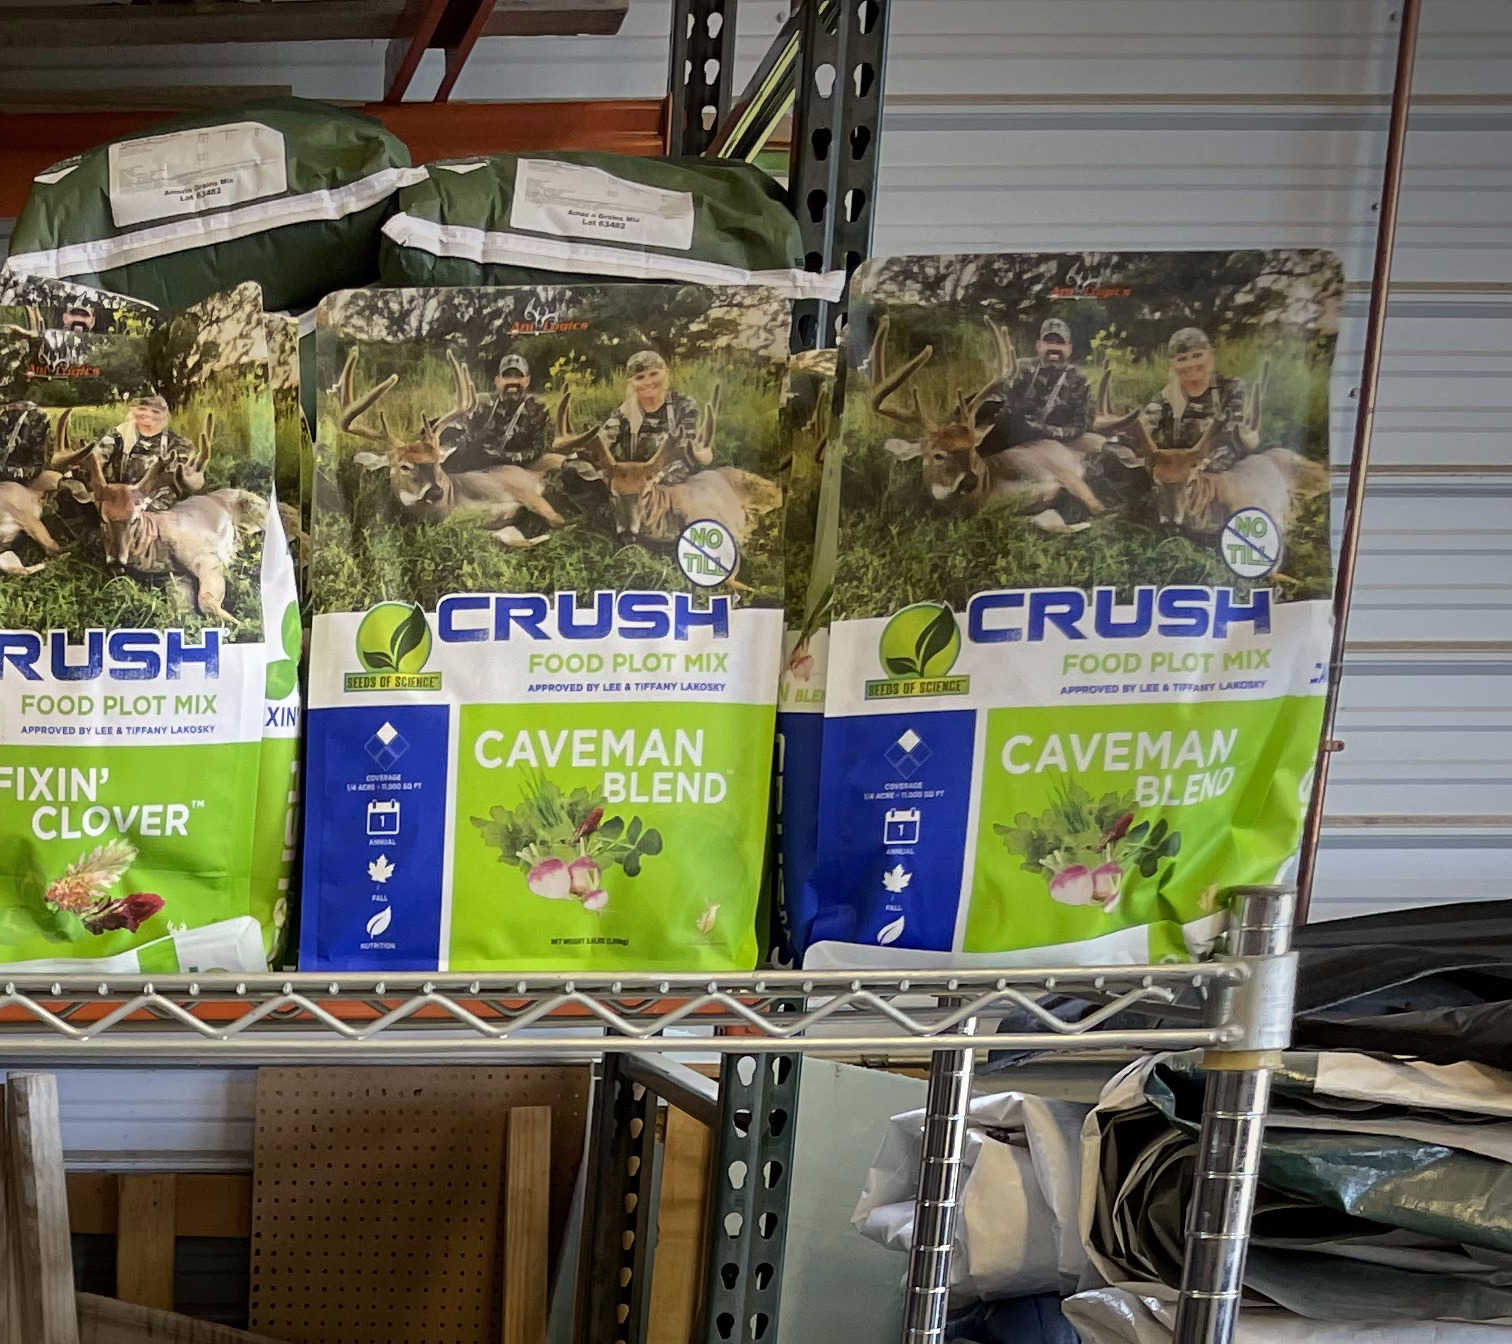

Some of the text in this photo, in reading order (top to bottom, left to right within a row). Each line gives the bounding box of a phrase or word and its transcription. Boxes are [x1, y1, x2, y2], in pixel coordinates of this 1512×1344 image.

[582, 218, 596, 226] Lot
[690, 527, 724, 549] NO
[1235, 516, 1268, 538] NO
[683, 553, 729, 576] TILL
[1227, 544, 1272, 566] TILL
[438, 593, 730, 642] CRUSH
[968, 589, 1271, 642] CRUSH
[528, 652, 729, 674] FOOD PLOT MIX
[1062, 648, 1272, 677] FOOD PLOT MIX
[347, 674, 436, 691] SEEDS OF SCIENCE
[527, 680, 726, 694] APPROVED BY LEE & TIFFANY LAKOSKY
[903, 680, 915, 697] OF
[918, 679, 963, 696] SCIENCE
[20, 693, 218, 716] FOOD PLOT MIX
[20, 725, 77, 736] APPROVED
[79, 726, 92, 736] BY
[94, 726, 113, 736] LEE
[125, 725, 168, 736] TIFFANY
[170, 724, 215, 736] LAKOSKY
[473, 728, 705, 769] CAVEMAN
[1001, 728, 1238, 776] CAVEMAN
[603, 771, 728, 805] BLEND
[1135, 765, 1236, 809] BLEND
[31, 803, 190, 841] CLOVER
